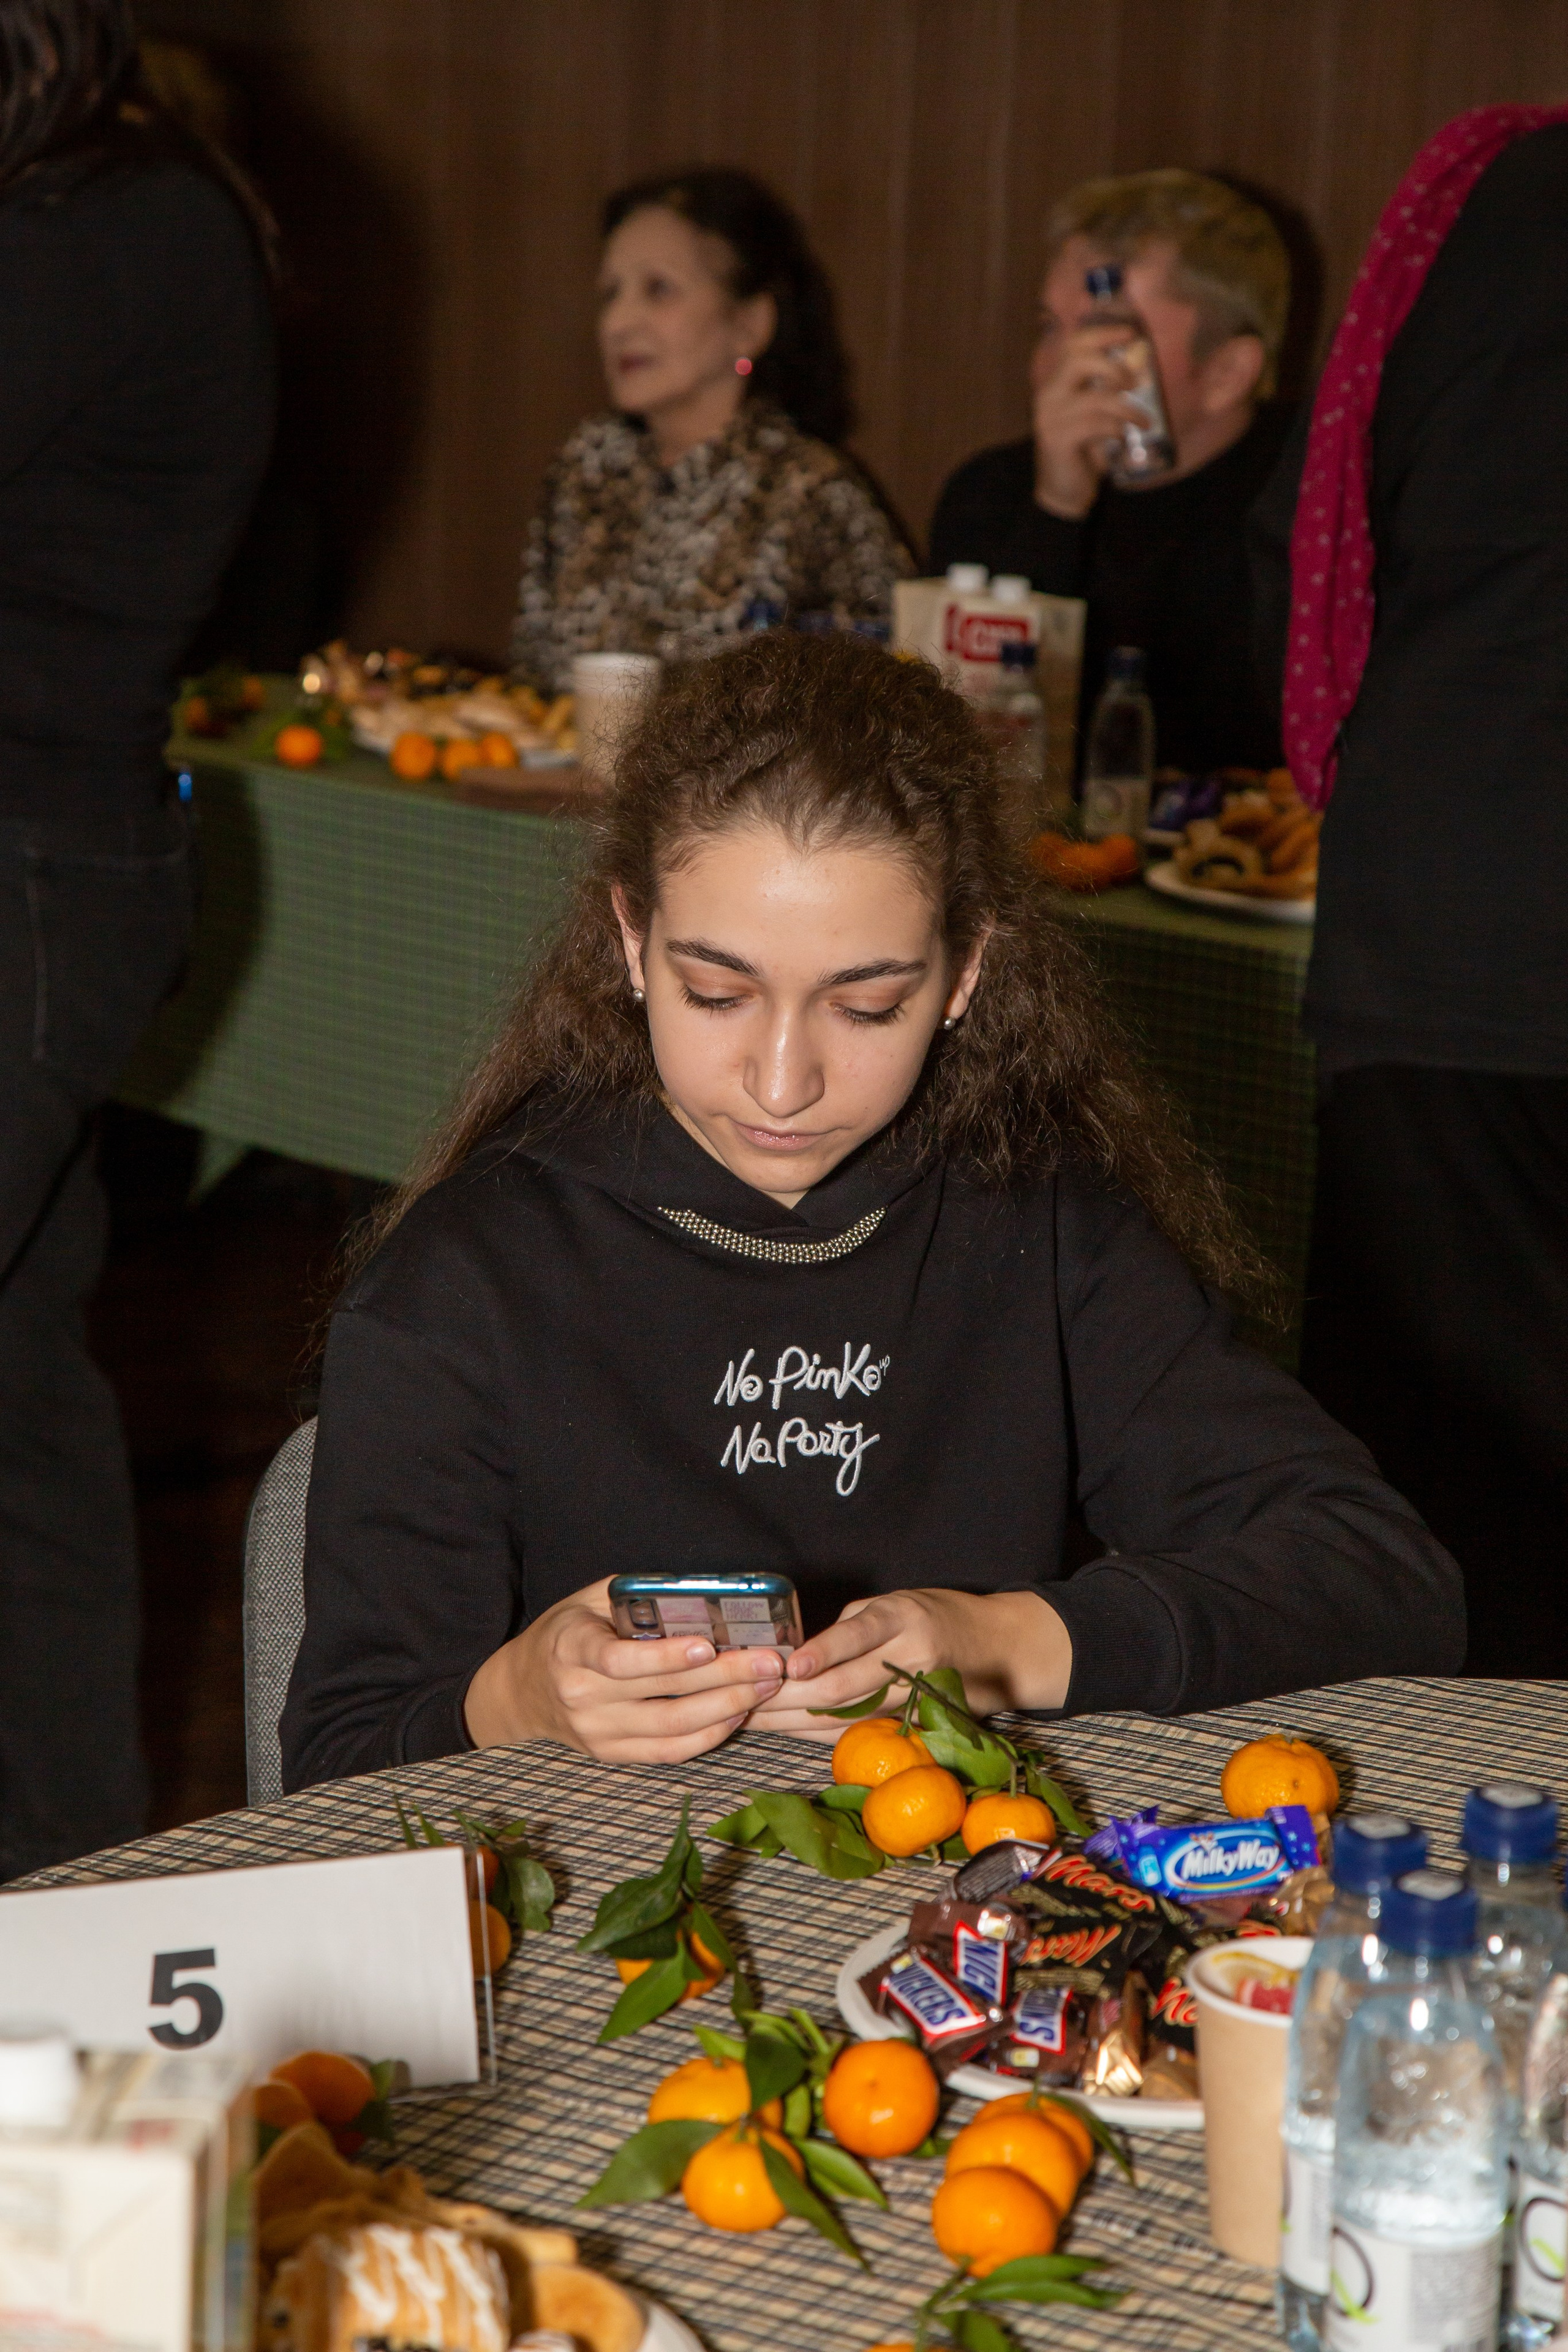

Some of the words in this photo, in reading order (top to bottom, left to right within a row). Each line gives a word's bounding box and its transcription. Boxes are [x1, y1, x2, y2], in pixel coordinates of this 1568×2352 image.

[714, 1348, 764, 1406] No
[1039, 1855, 1155, 1912] Mars
[148, 1947, 225, 2051] 5
